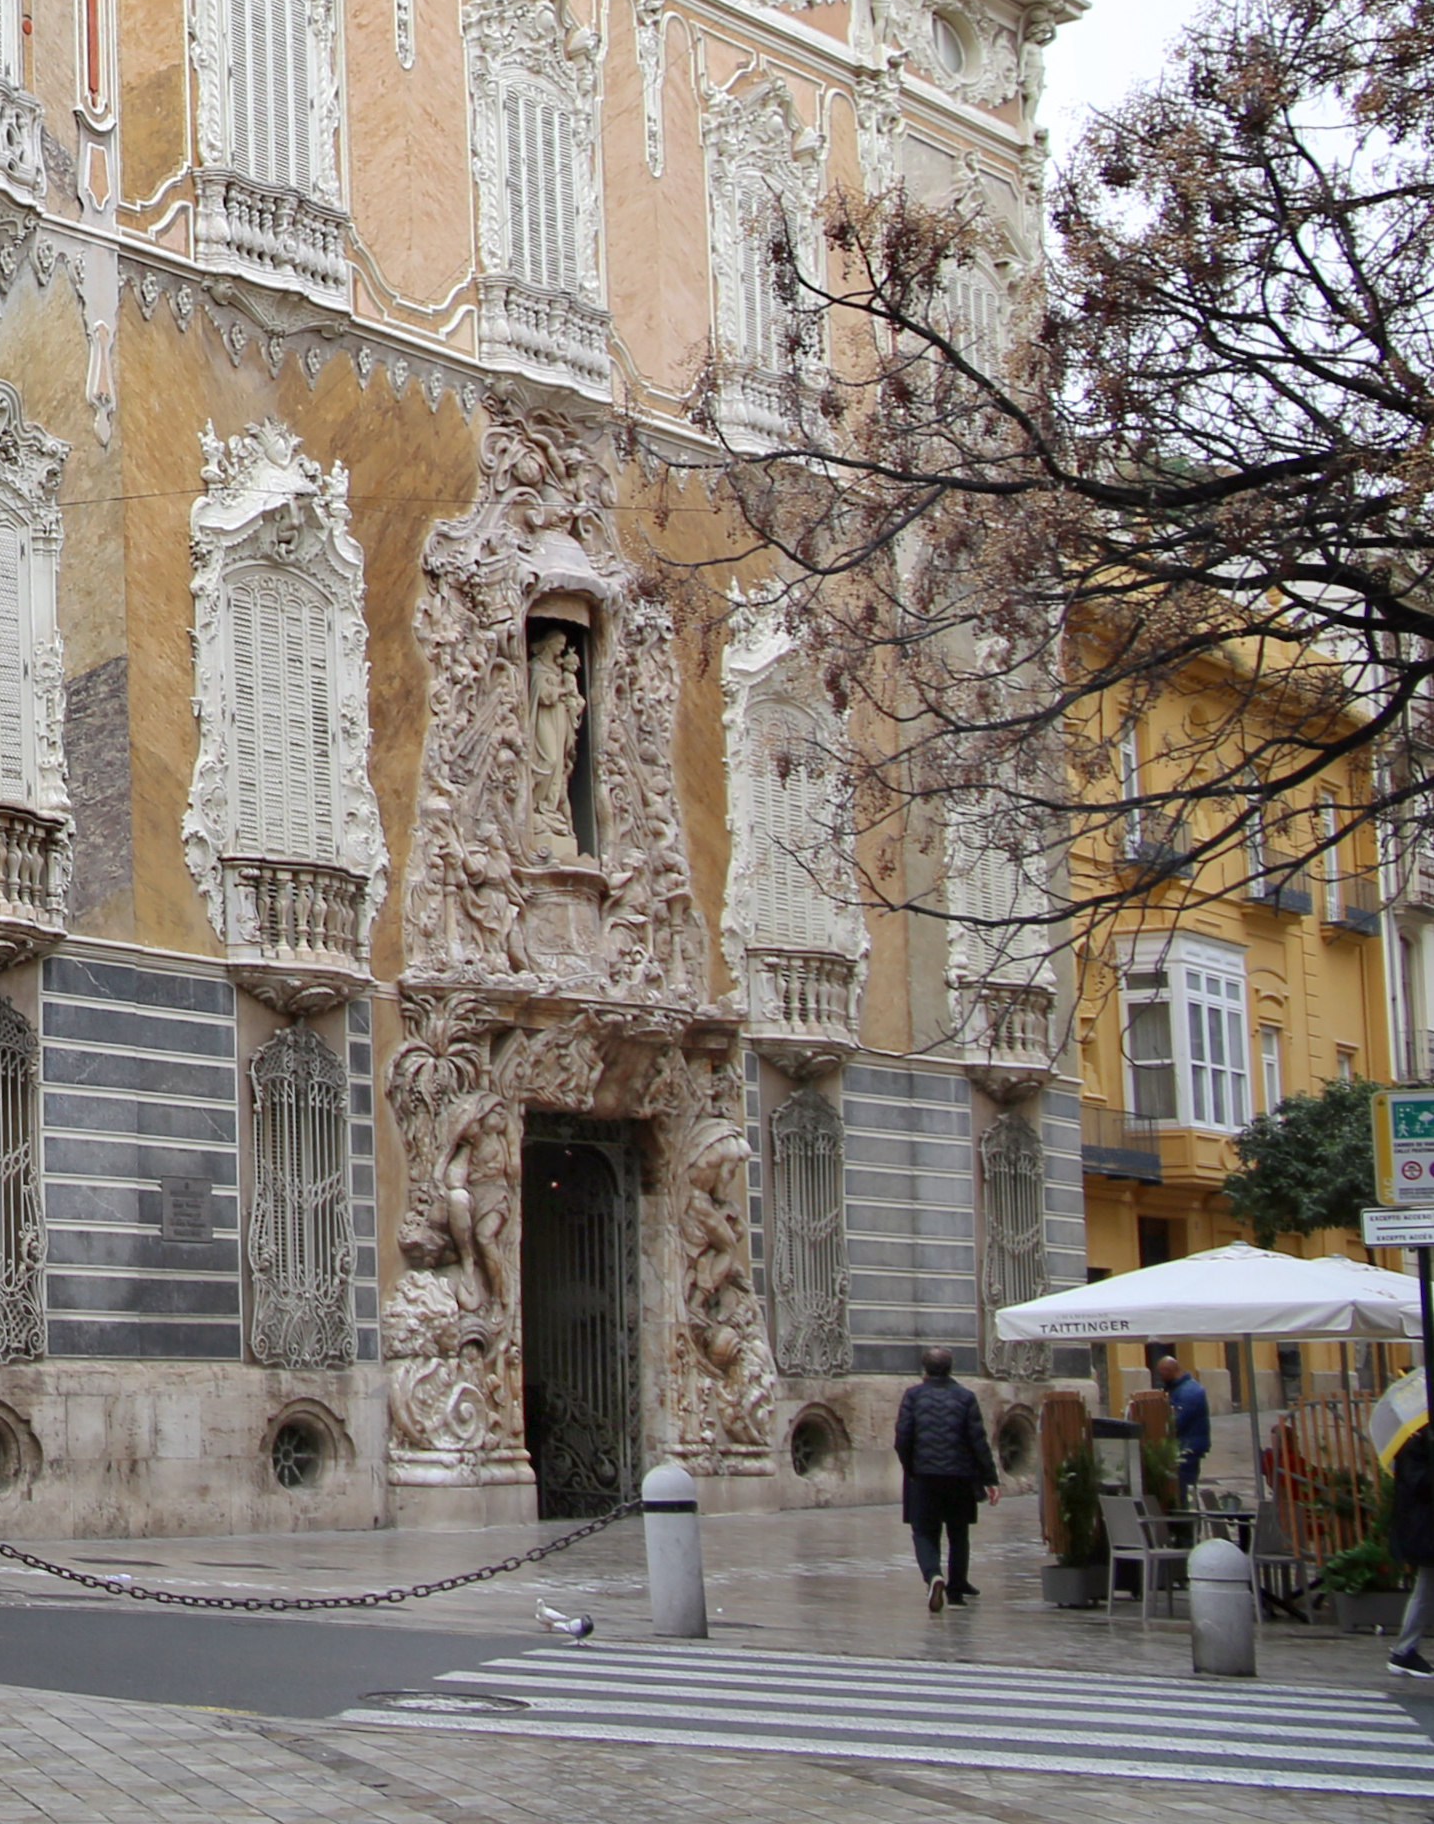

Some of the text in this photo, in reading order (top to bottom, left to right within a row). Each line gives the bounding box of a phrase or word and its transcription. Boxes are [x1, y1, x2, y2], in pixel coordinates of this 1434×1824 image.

[1369, 1213, 1432, 1222] EXCEPTO ACCESO
[1376, 1234, 1407, 1242] EXCEPTE
[1039, 1320, 1130, 1334] TAITTINGER
